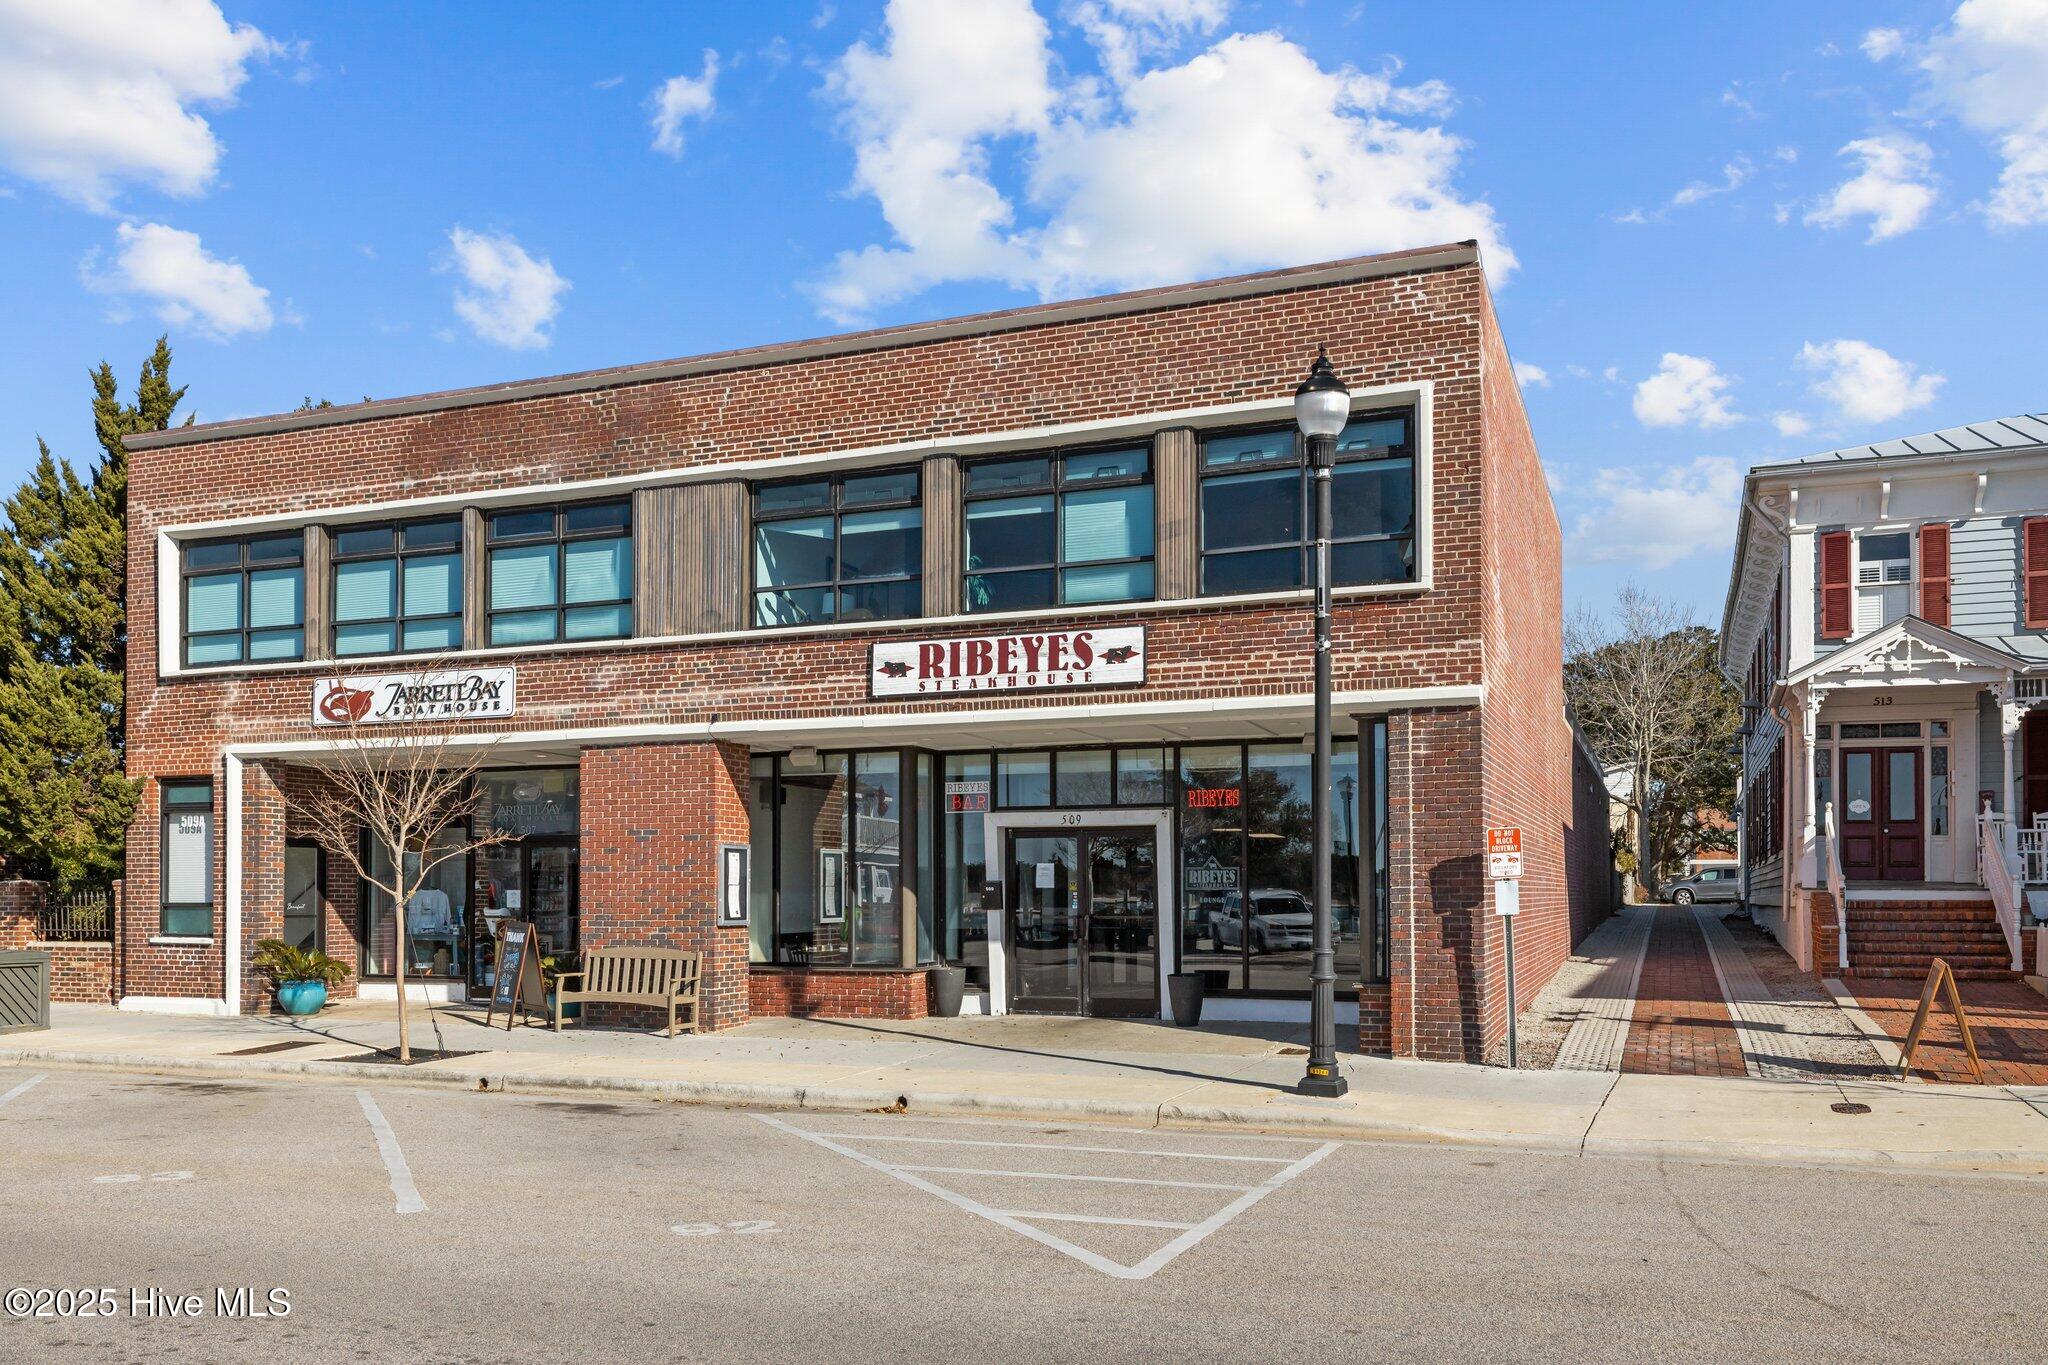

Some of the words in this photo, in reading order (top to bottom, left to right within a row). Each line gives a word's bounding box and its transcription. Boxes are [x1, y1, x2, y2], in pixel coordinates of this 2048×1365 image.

[918, 632, 1094, 680] RIBEYES
[918, 671, 1093, 693] STEAKHOUSE
[375, 681, 468, 718] JARRETT
[464, 675, 506, 700] BAY
[1873, 696, 1893, 706] 513
[393, 704, 436, 716] BOAT
[441, 700, 501, 714] HOUSE
[946, 782, 989, 793] RIBEYES
[951, 793, 987, 811] BAR
[1188, 789, 1240, 808] RIBEYES
[181, 815, 205, 827] 509A
[1061, 814, 1082, 826] 509
[520, 825, 537, 835] 507
[1189, 869, 1236, 884] RIBEYES
[1200, 896, 1226, 904] LOUNGE
[506, 932, 525, 943] THANK
